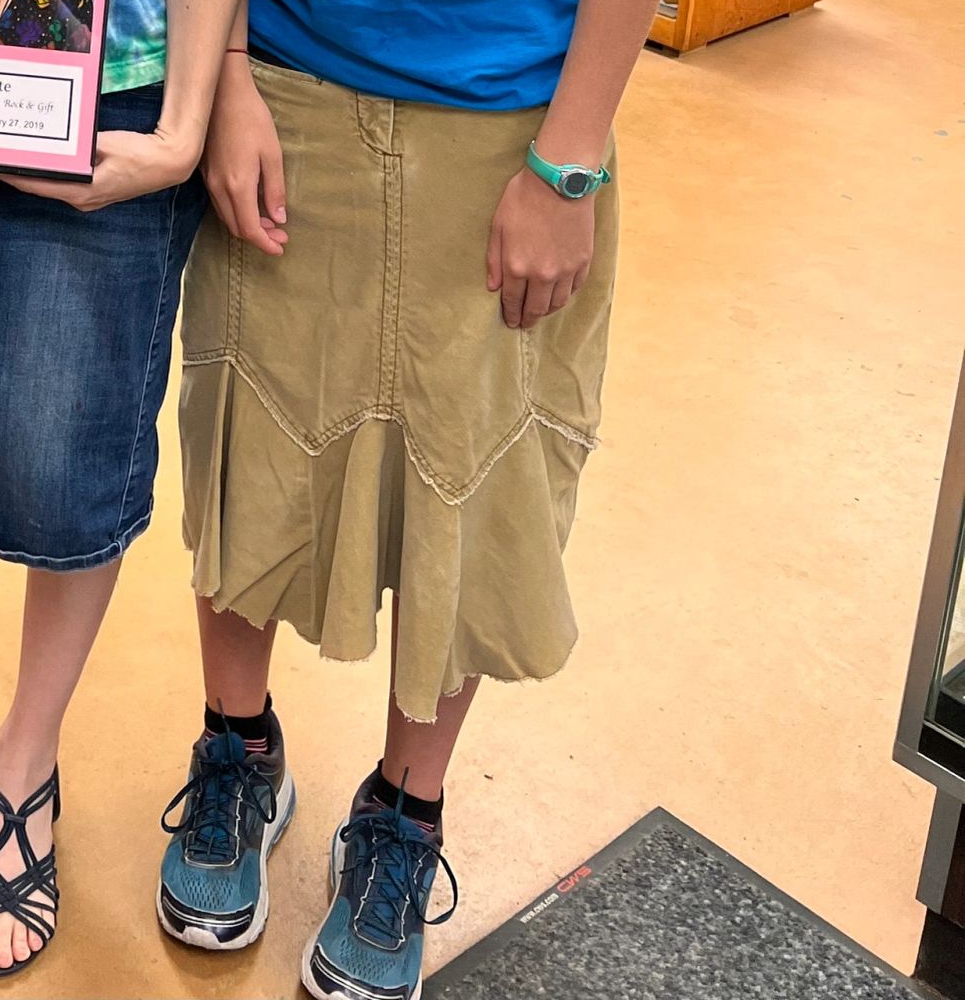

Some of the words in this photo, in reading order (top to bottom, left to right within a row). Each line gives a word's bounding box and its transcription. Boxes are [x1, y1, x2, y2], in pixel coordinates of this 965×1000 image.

[3, 99, 25, 110] Rock
[26, 101, 34, 109] &
[37, 101, 54, 114] Gift
[8, 119, 21, 129] 27,
[24, 120, 44, 130] 2019
[556, 866, 592, 893] CWS
